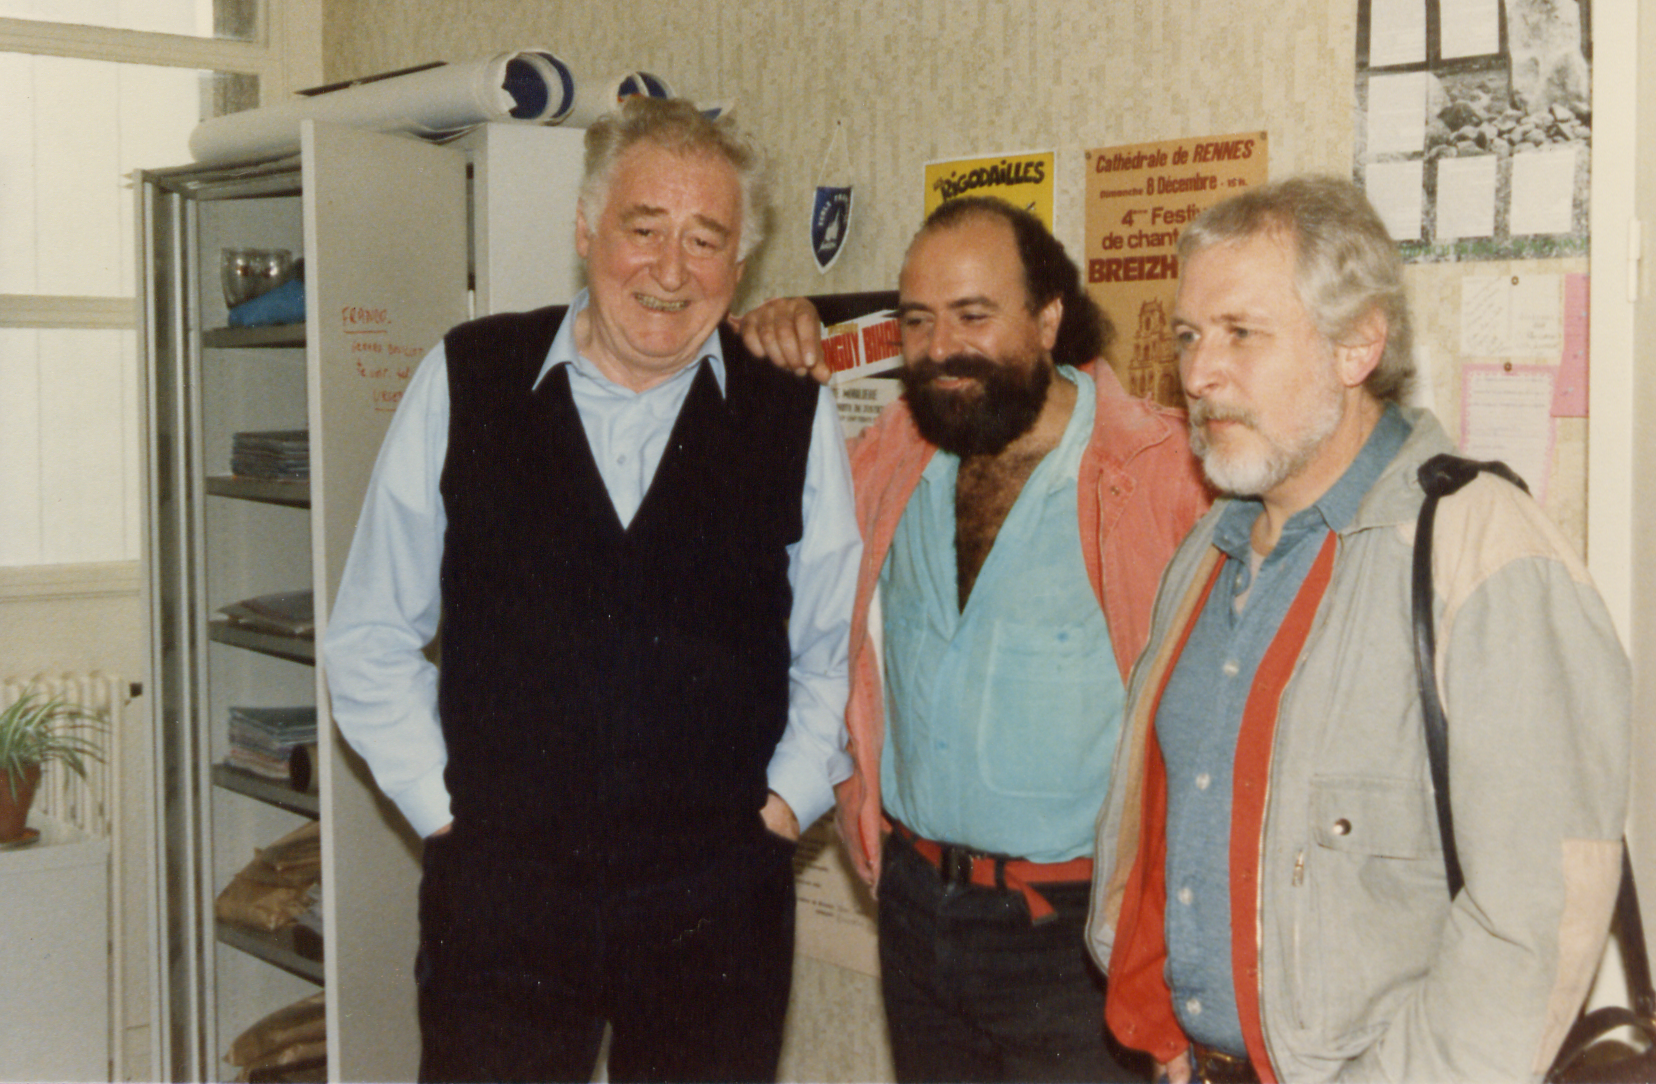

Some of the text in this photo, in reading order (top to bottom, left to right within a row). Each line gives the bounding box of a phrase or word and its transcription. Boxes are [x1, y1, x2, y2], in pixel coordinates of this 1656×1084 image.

[1096, 139, 1255, 173] Cathédrale de RENNES
[1146, 177, 1154, 195] 8
[1157, 172, 1217, 195] Décembre
[1102, 231, 1124, 250] de
[1088, 254, 1178, 283] BREIZH
